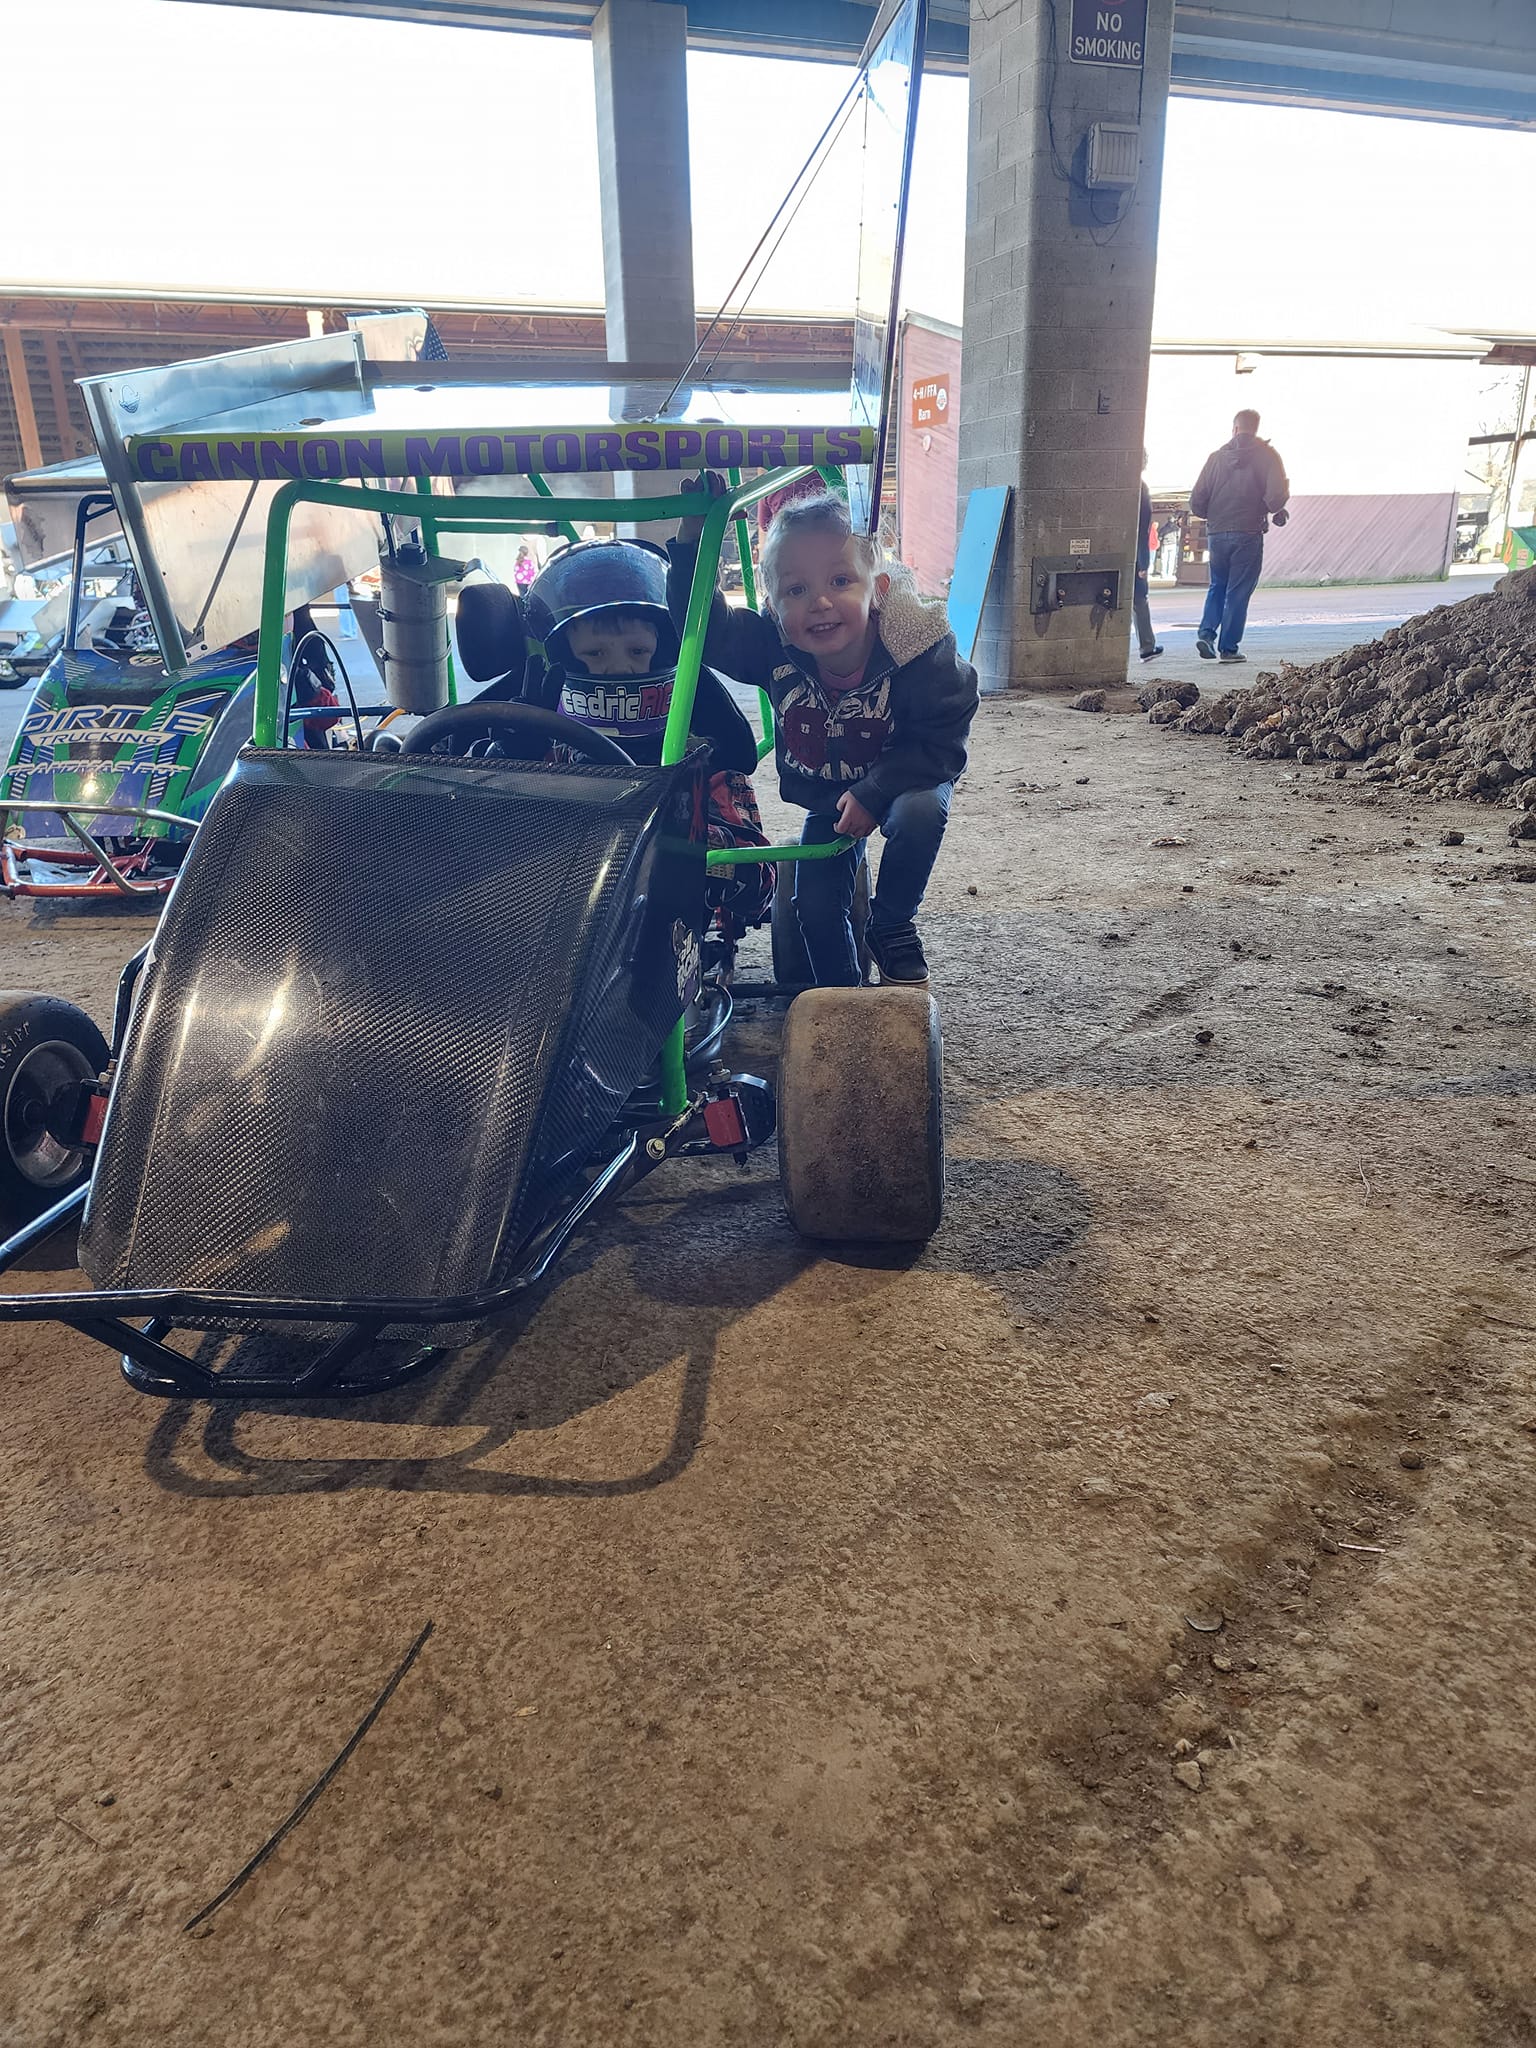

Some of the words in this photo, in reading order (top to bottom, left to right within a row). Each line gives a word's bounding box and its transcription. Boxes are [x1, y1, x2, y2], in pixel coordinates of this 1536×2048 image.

[1096, 11, 1122, 33] NO
[1075, 36, 1141, 60] SMOKING
[137, 437, 386, 481] CANNON
[405, 427, 862, 478] MOTORSPORTS
[22, 704, 153, 735] DIRT
[39, 731, 163, 746] TRUCKING
